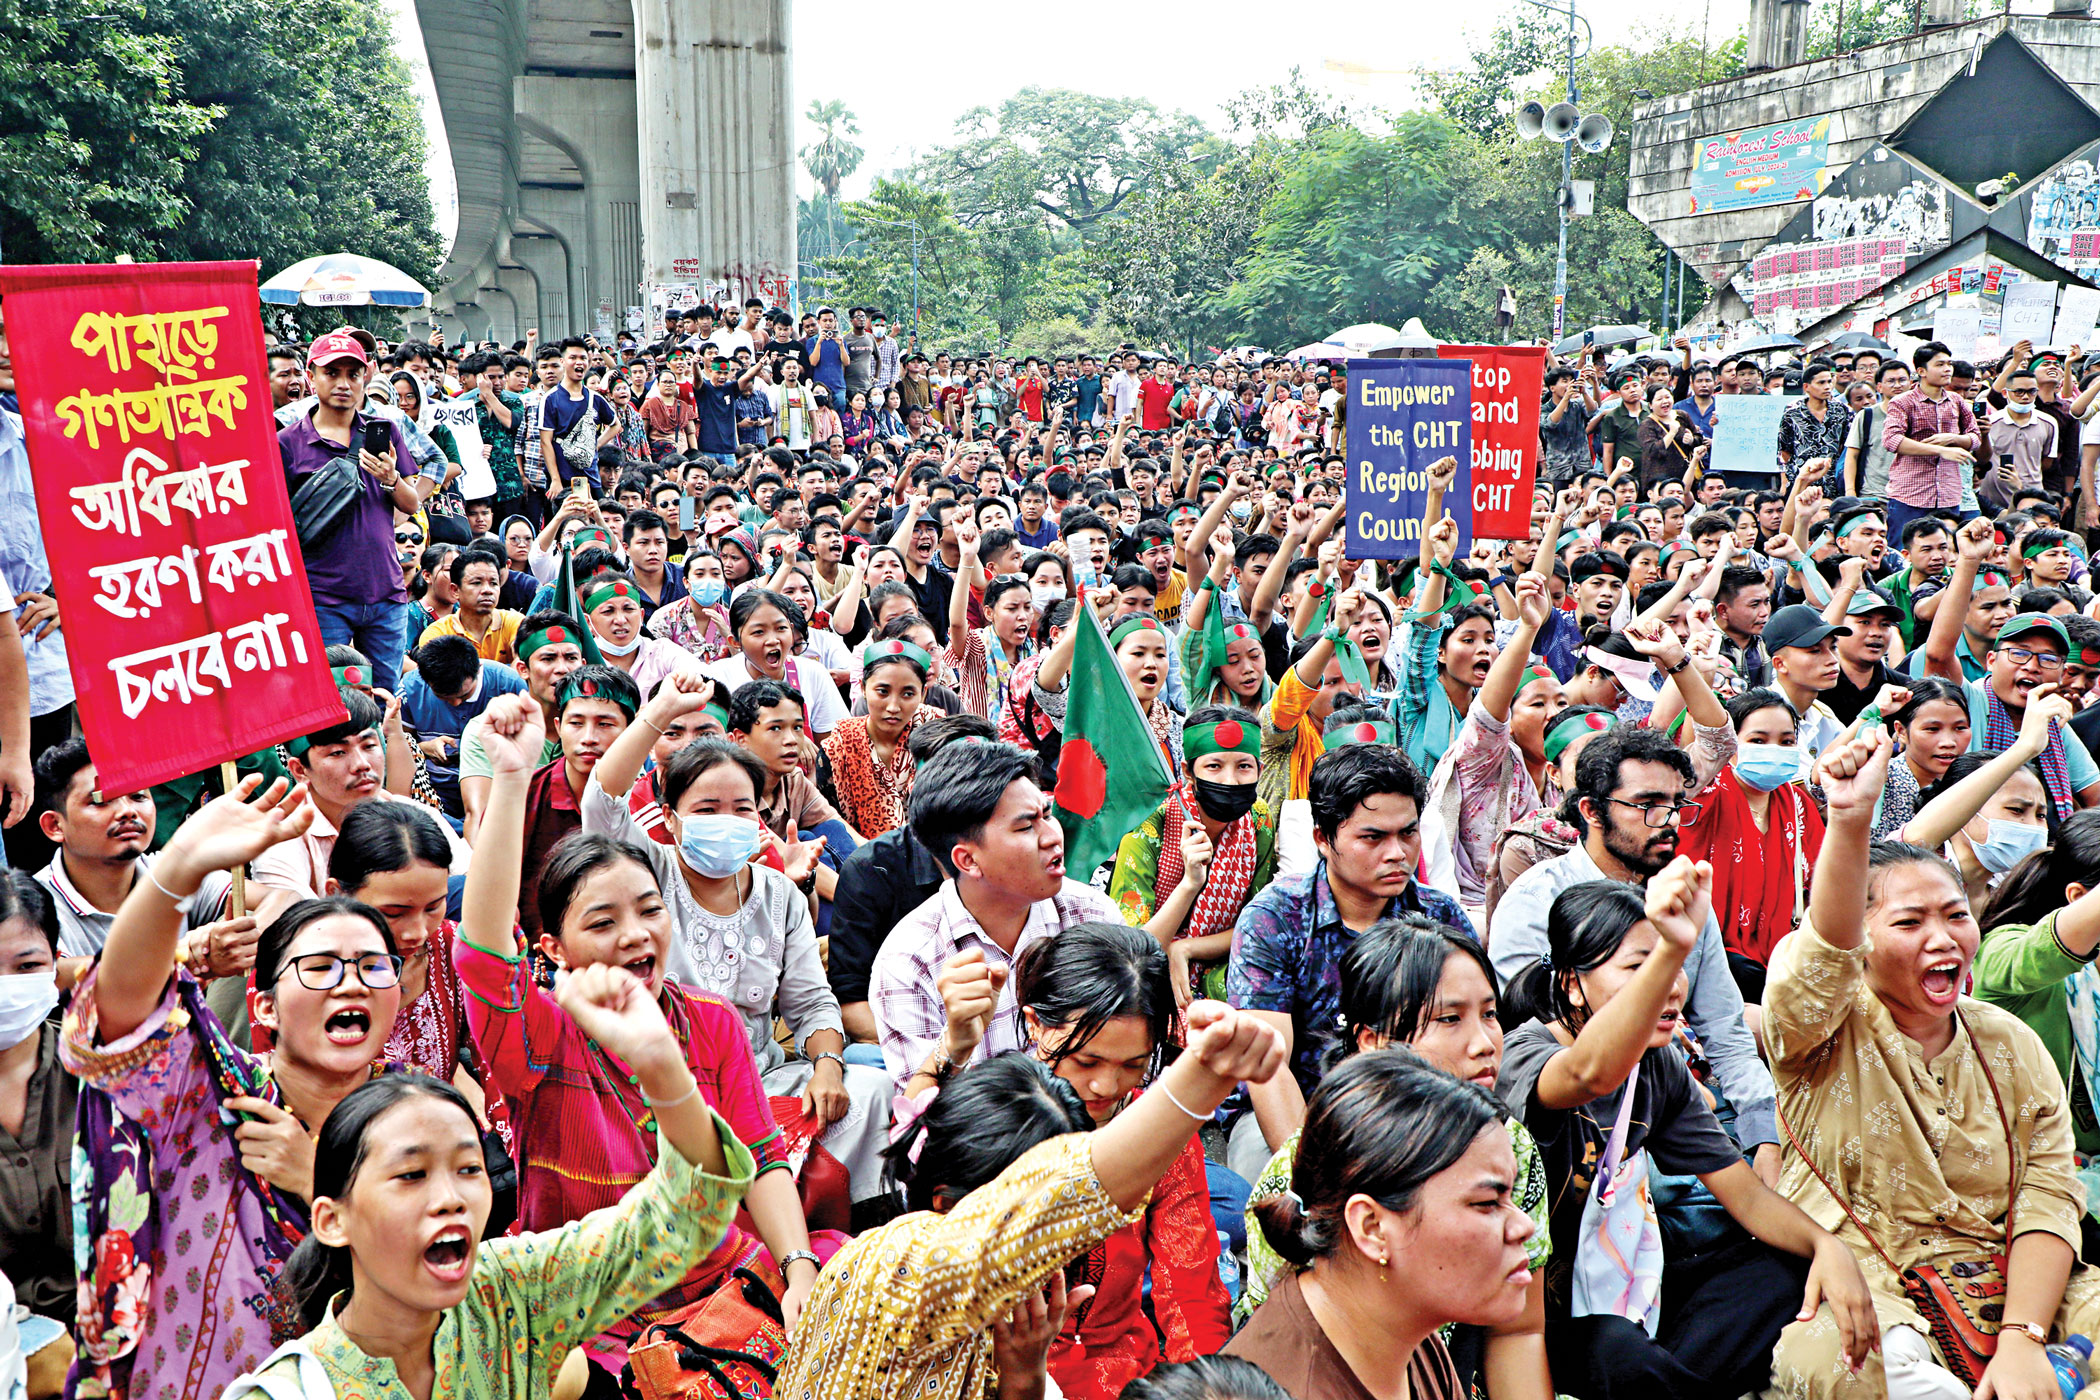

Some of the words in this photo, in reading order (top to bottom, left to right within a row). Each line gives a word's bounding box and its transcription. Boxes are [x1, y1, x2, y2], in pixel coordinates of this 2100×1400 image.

[1706, 135, 1766, 160] Rainforest
[1769, 125, 1813, 149] School
[319, 294, 352, 302] IGLOO
[1940, 318, 1969, 330] STOP
[2014, 310, 2040, 323] CHT
[70, 306, 229, 374] পাহাড়ে
[328, 338, 351, 350] SF
[1472, 364, 1510, 394] top
[54, 364, 248, 450] গণতান্ত্রিক
[1361, 378, 1456, 412] Empower
[1471, 396, 1518, 424] and
[1369, 424, 1404, 447] the
[1413, 420, 1462, 448] CHT
[1470, 439, 1522, 480] bbing
[69, 447, 250, 537] অধিকার
[1473, 483, 1515, 512] CHT
[1359, 508, 1451, 541] Coun
[88, 544, 202, 618] হরণ
[206, 529, 292, 593] করা
